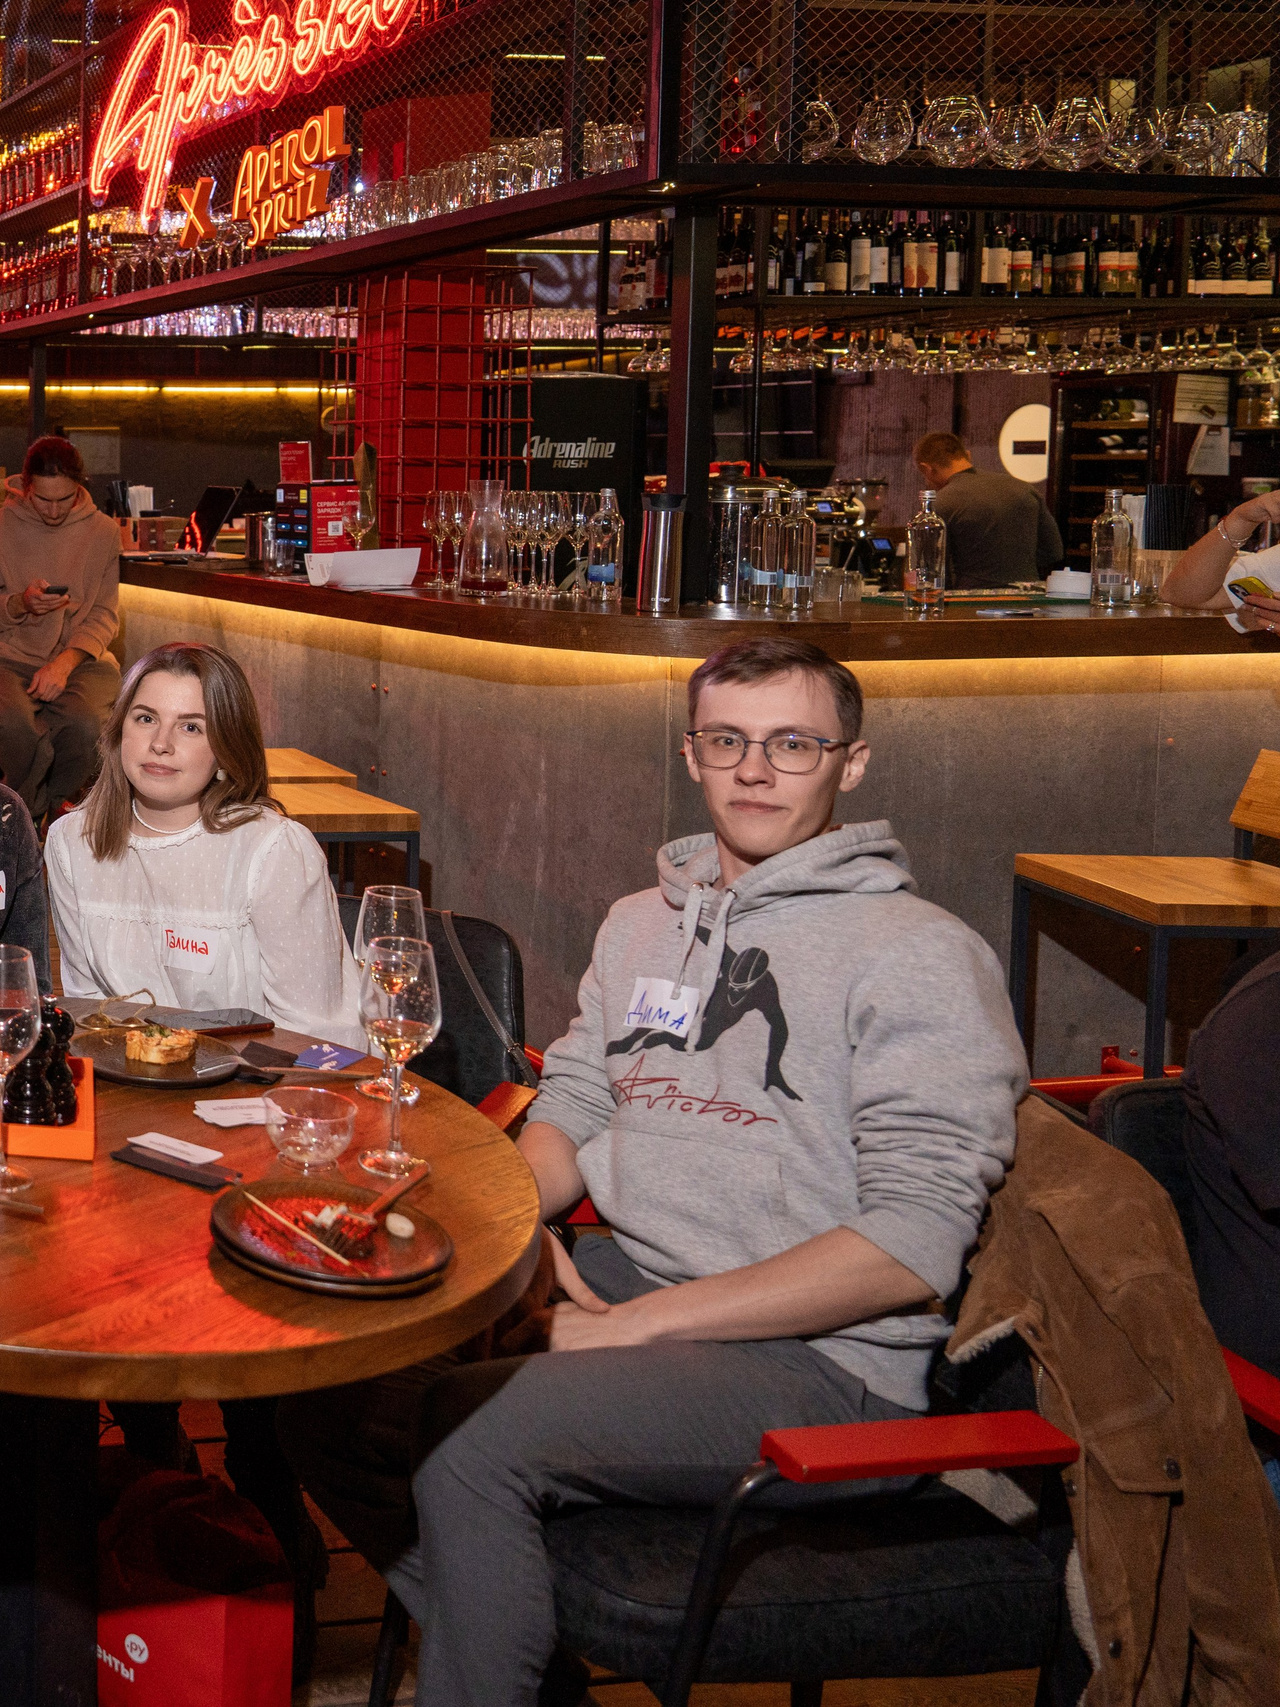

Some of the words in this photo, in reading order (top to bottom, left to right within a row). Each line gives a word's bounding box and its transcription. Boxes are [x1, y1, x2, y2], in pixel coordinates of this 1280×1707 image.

[232, 106, 350, 221] APEROL
[523, 436, 616, 465] Adrenaline
[552, 460, 589, 468] RUSH
[165, 929, 209, 955] Галина
